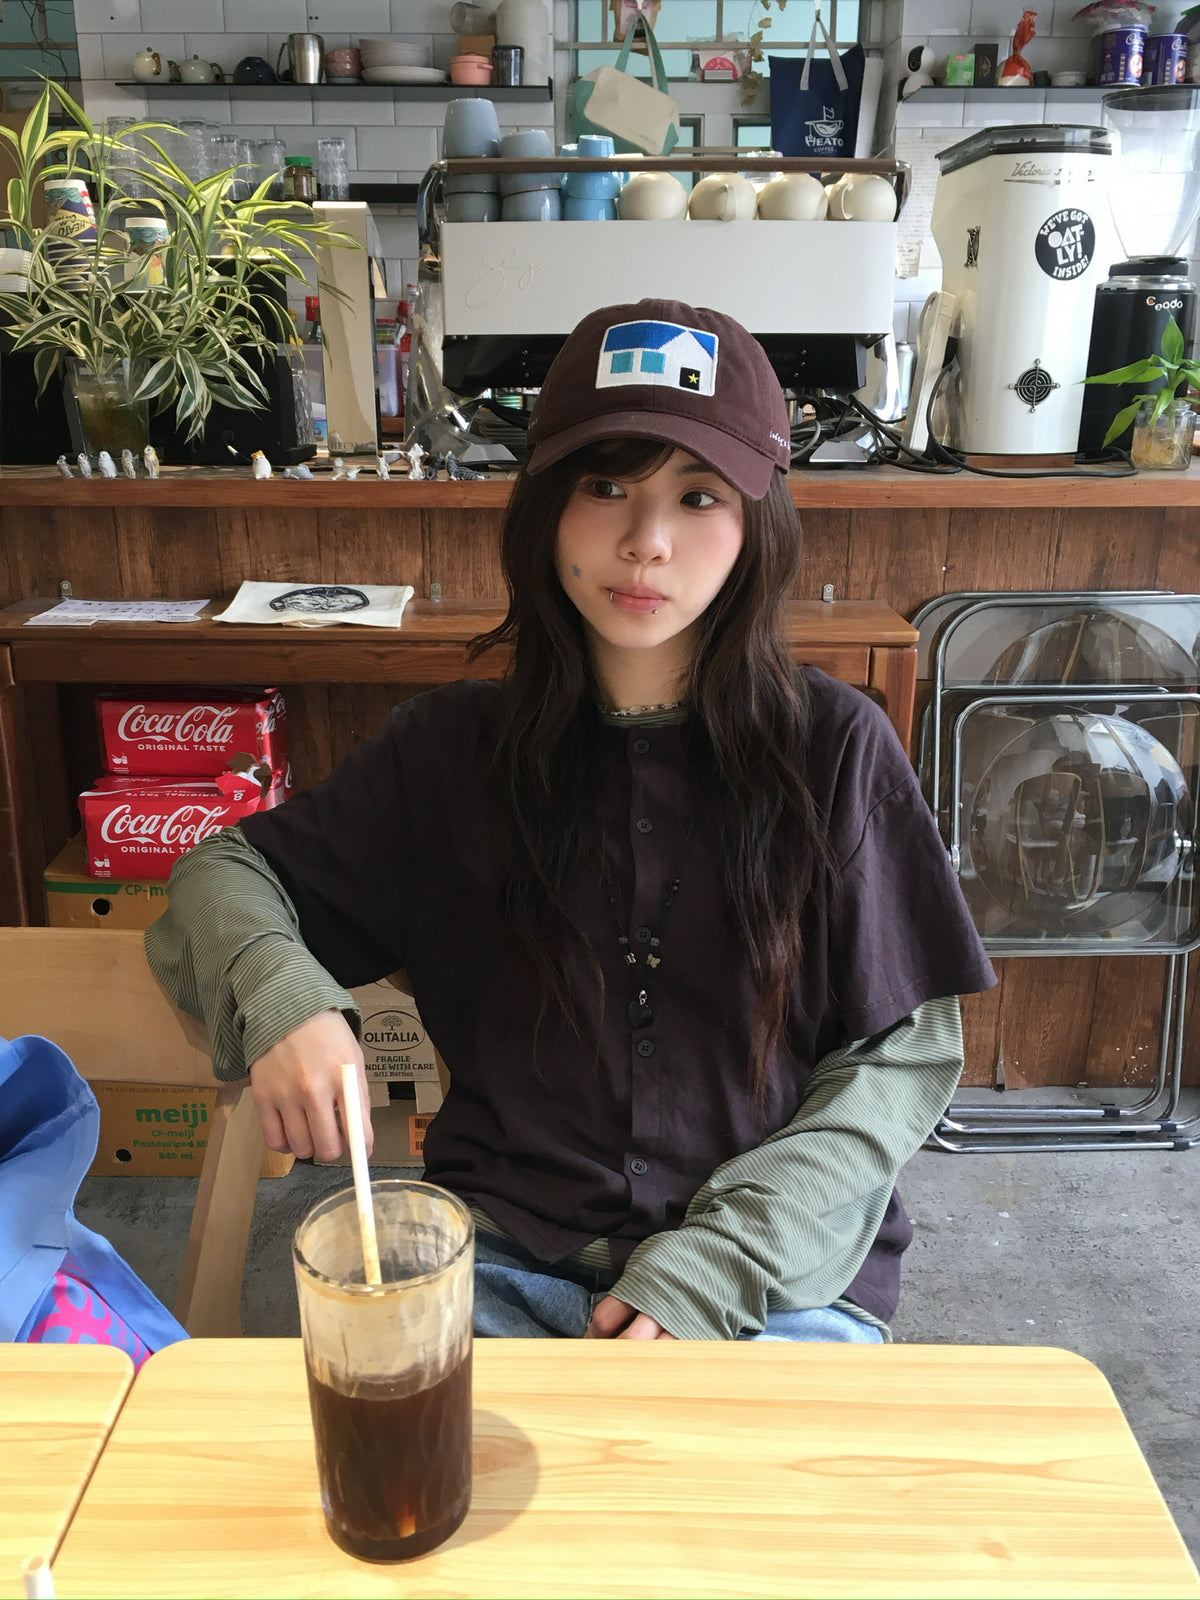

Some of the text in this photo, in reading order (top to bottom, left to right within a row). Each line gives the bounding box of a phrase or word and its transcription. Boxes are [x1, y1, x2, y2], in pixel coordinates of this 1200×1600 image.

[804, 135, 844, 147] HEATO
[1011, 161, 1052, 177] Victoria
[1039, 210, 1089, 236] WE'VE GOT
[1056, 241, 1083, 265] LY!
[1052, 254, 1090, 278] INSIDE!
[1146, 295, 1183, 311] Ceado
[117, 704, 240, 744] Coca-Cola
[137, 743, 226, 752] ORIGINAL TASTE
[121, 846, 175, 854] ORIGINAL
[125, 884, 164, 896] CP-m
[364, 1032, 420, 1043] OLITALIA
[375, 1055, 411, 1063] FRAGILE
[365, 1063, 387, 1071] NDLE
[136, 1102, 208, 1128] meiji
[151, 1129, 195, 1140] CP-meiji
[132, 1139, 208, 1148] Pasteurized Mi
